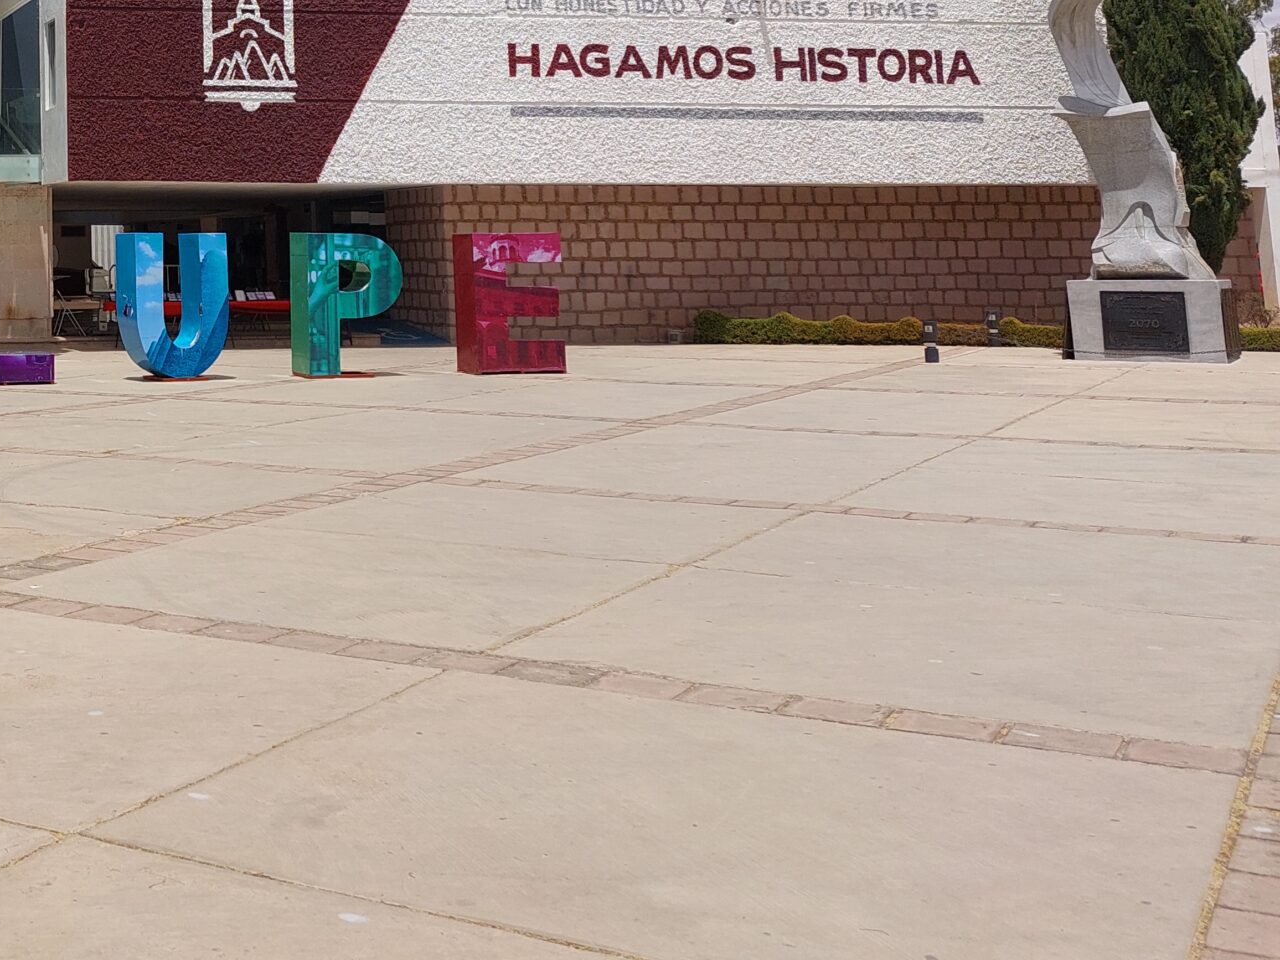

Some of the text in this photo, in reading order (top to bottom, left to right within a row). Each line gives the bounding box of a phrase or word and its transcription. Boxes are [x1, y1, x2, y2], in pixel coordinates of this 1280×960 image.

[847, 1, 939, 18] FIRMES
[508, 43, 981, 85] HAGAMOS HISTORIA
